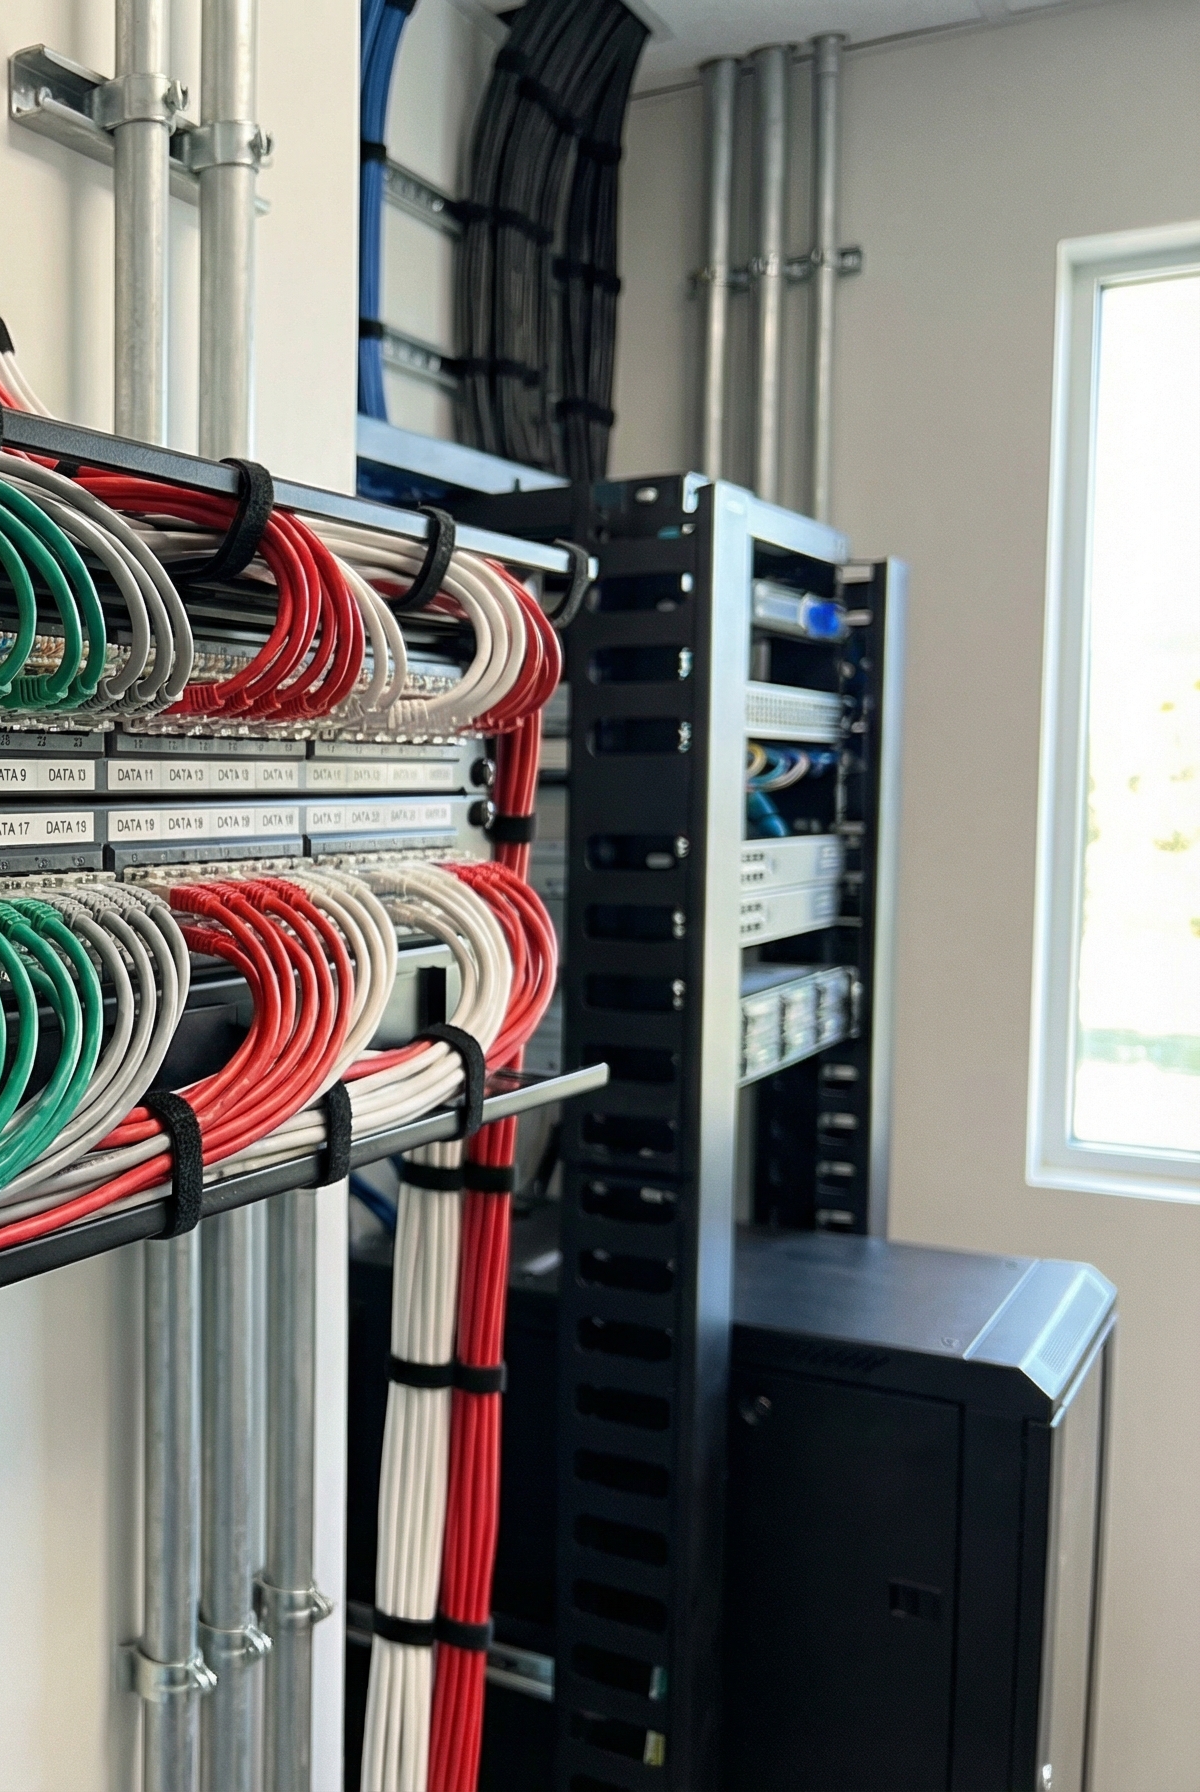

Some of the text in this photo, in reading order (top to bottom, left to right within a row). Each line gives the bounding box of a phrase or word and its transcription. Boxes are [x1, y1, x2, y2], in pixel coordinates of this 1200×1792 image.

[20, 769, 26, 781] 9
[49, 769, 75, 781] DATA
[118, 769, 142, 781] DATA
[170, 769, 192, 781] DATA
[218, 769, 239, 781] DATA
[18, 822, 30, 835] 17
[47, 821, 73, 834] DATA
[117, 819, 142, 832] DATA
[169, 818, 192, 830] DATA
